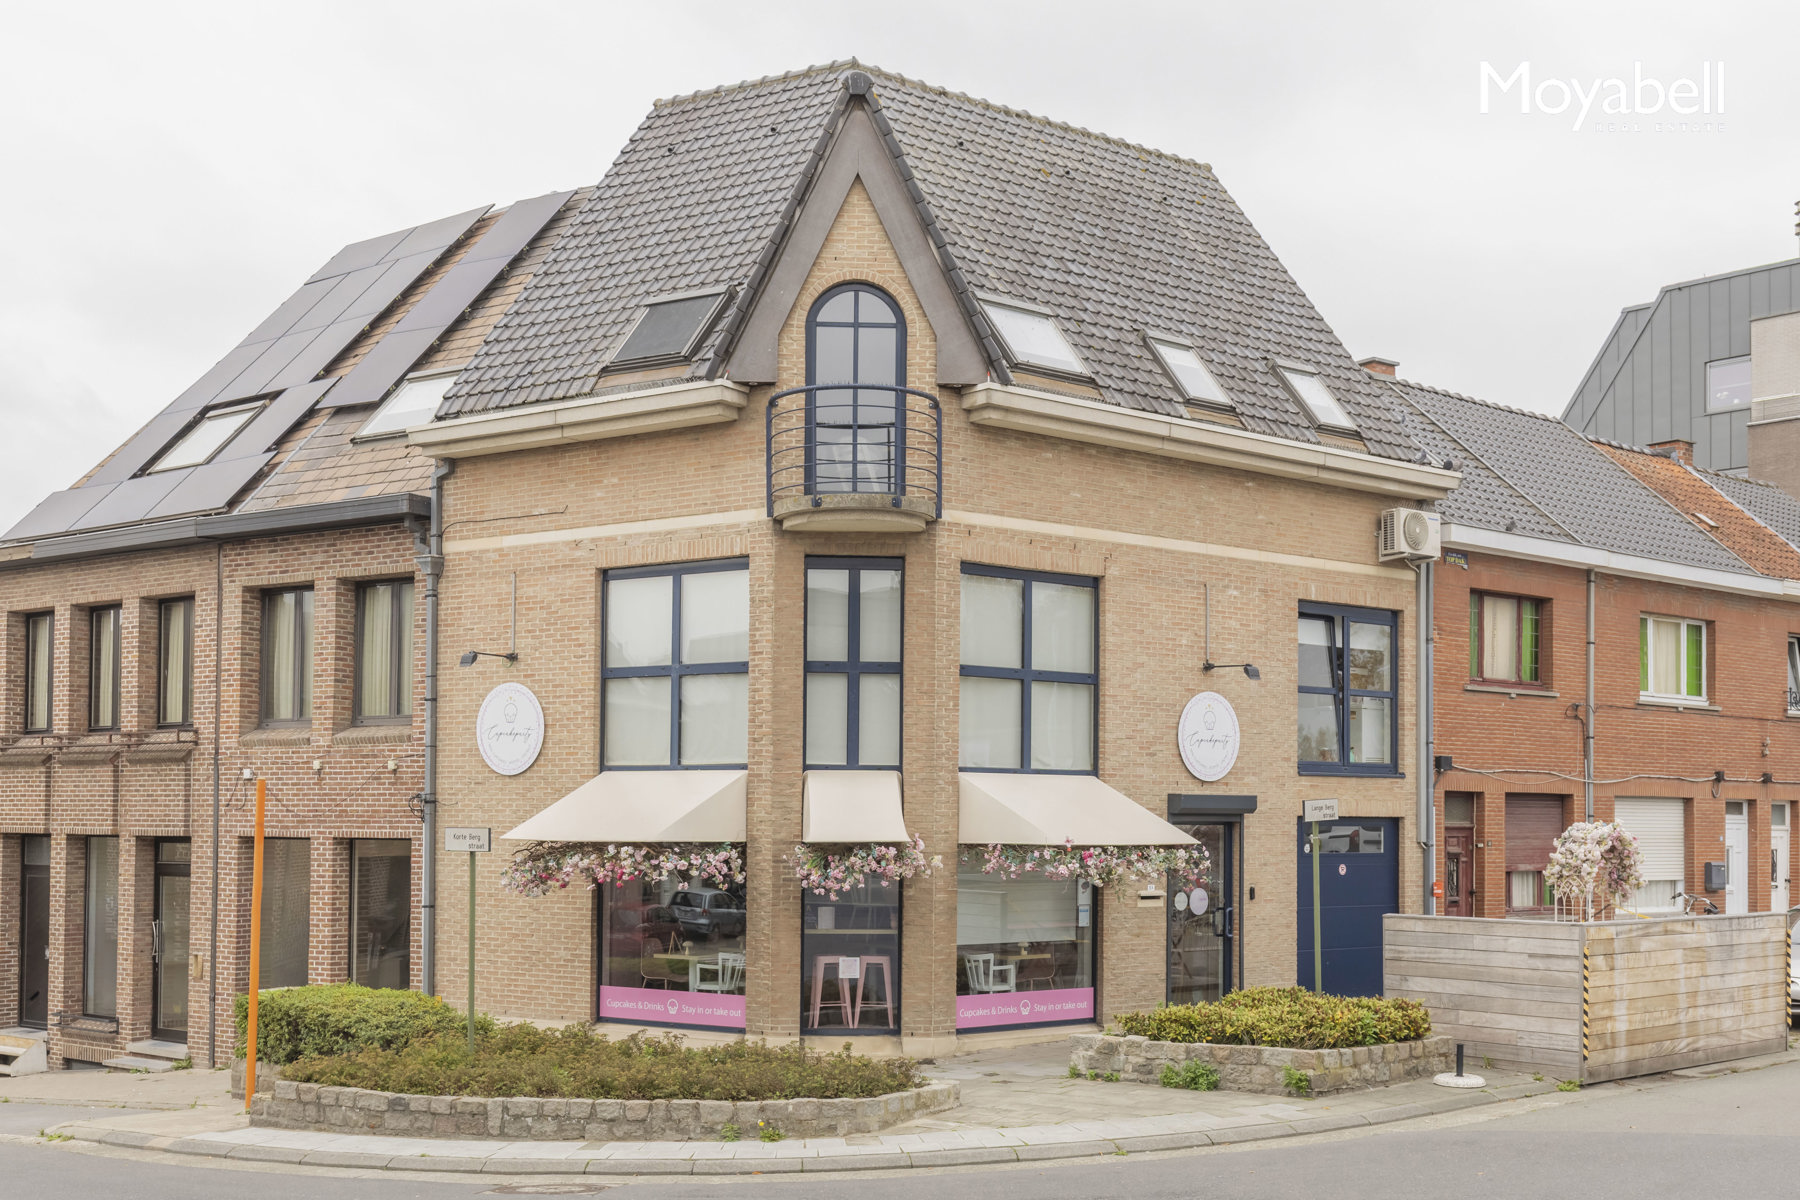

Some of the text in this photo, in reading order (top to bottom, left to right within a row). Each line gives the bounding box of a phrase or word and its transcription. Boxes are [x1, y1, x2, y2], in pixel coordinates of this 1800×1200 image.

[606, 998, 637, 1009] Cupcakes
[643, 1001, 665, 1011] Drinks
[681, 1004, 696, 1015] Stay
[697, 1006, 704, 1014] in
[713, 1007, 728, 1016] take
[729, 1009, 741, 1017] out
[959, 1007, 990, 1018] Cupcakes
[997, 1005, 1018, 1014] Drinks
[1033, 1003, 1047, 1013] Stay
[1048, 1002, 1055, 1011] in
[1055, 1003, 1062, 1011] or
[1062, 1000, 1076, 1009] take
[1076, 1000, 1088, 1008] out
